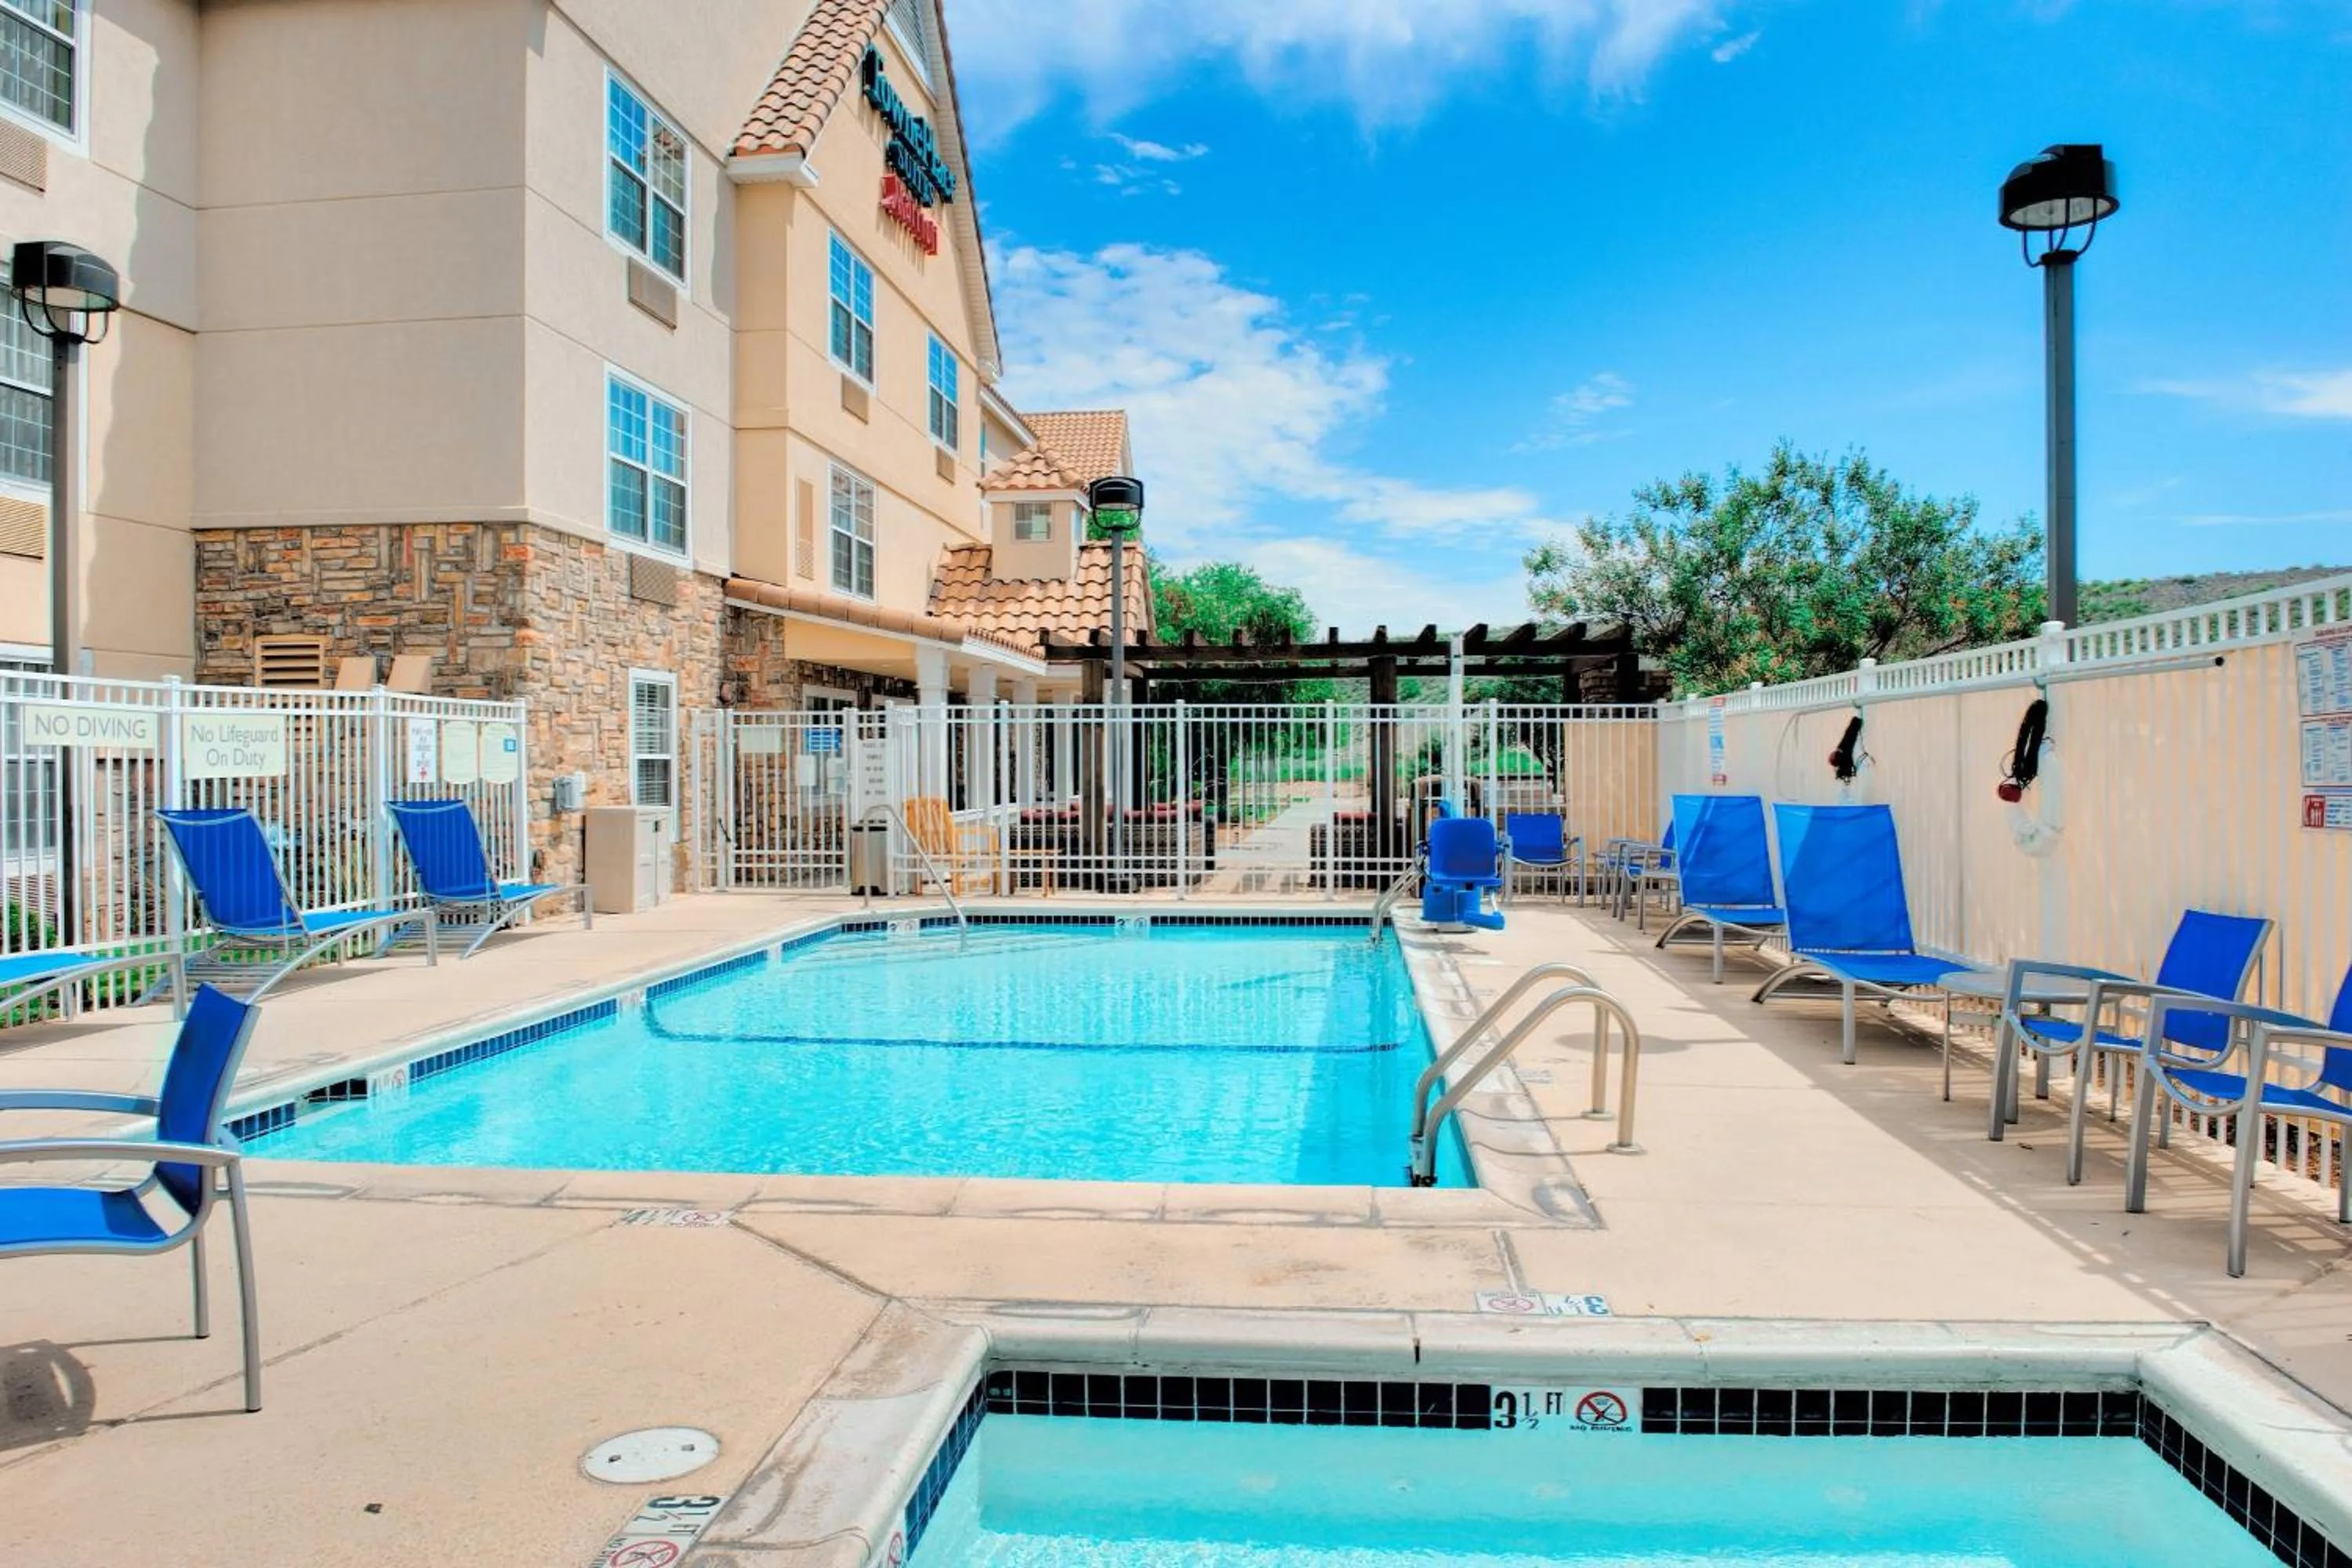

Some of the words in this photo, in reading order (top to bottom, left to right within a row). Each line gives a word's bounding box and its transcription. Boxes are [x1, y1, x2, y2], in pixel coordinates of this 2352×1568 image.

[34, 714, 70, 736] NO
[77, 716, 147, 739] DIVING
[191, 724, 214, 742] No
[219, 724, 279, 748] Lifeguard
[206, 748, 228, 766] On
[233, 748, 266, 771] Duty
[1494, 1390, 1517, 1428] 3
[1545, 1392, 1563, 1415] FT
